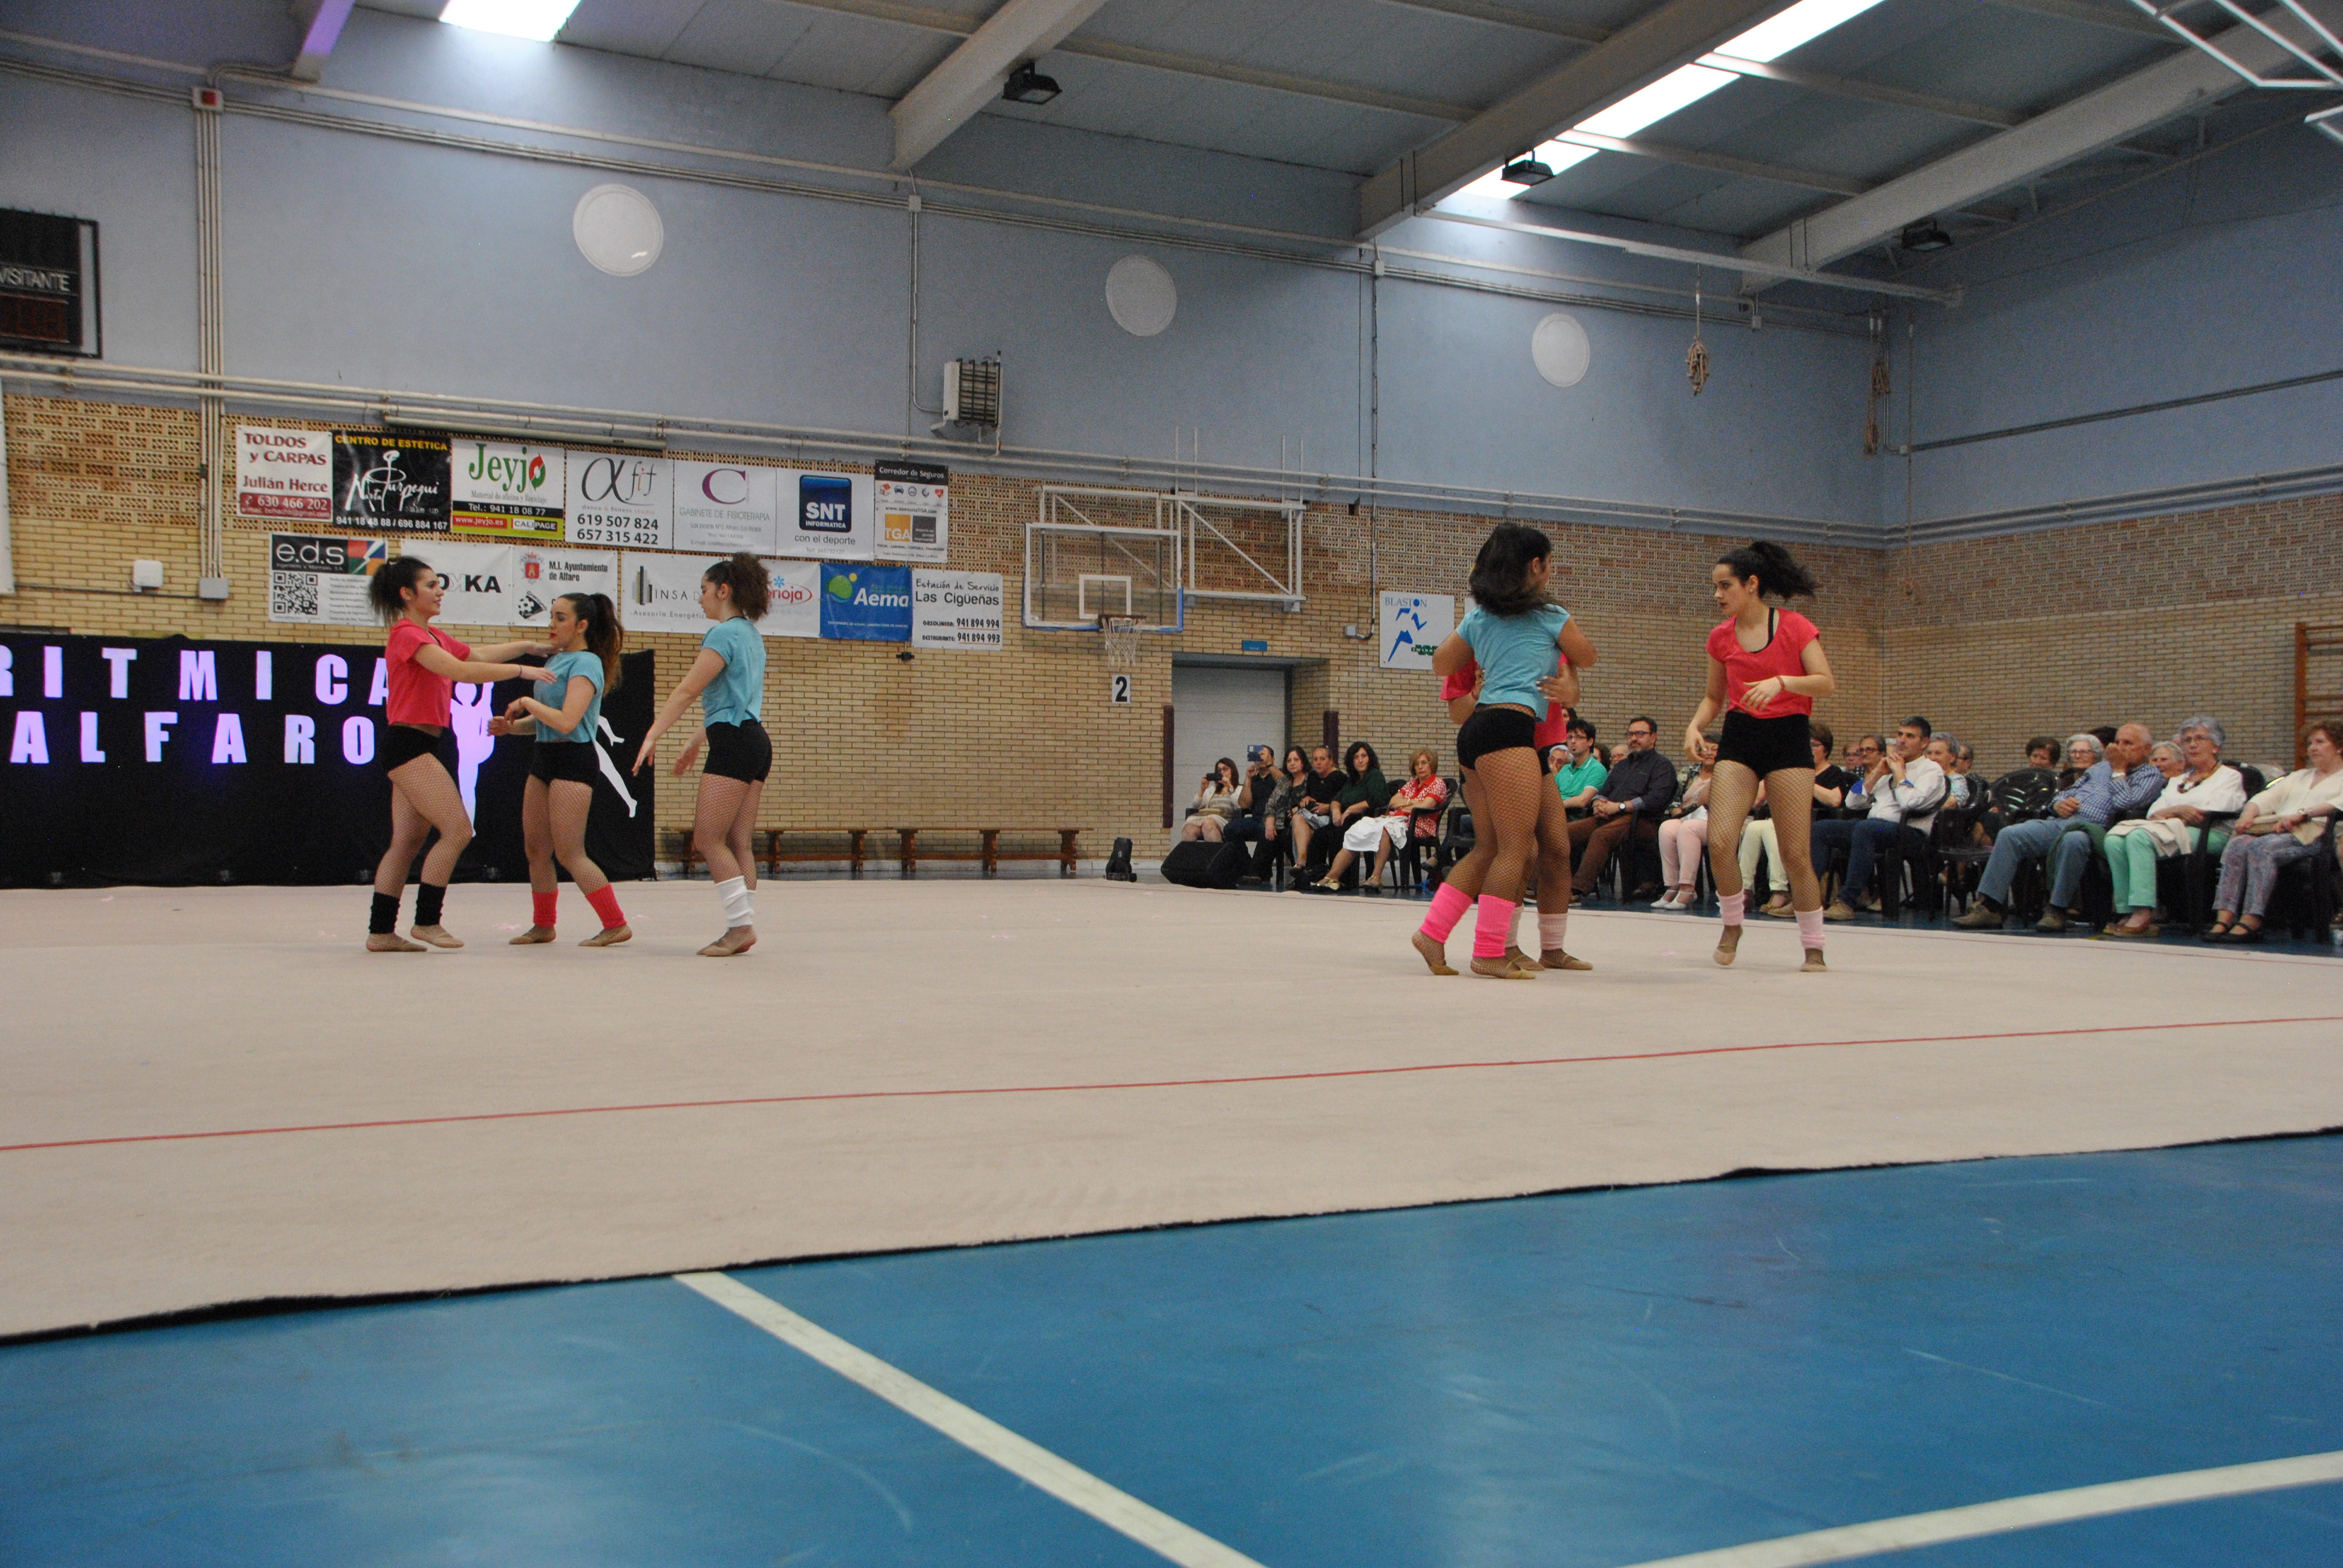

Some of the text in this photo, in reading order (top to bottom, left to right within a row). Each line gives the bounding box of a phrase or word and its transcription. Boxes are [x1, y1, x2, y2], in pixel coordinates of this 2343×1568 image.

[245, 433, 307, 448] TOLDOS
[335, 435, 379, 445] CENTRO
[381, 438, 395, 446] DE
[250, 451, 327, 465] y CARPAS
[468, 443, 546, 493] Jeyjo
[920, 471, 944, 479] Seguros
[243, 475, 328, 492] Julián Herce
[702, 468, 746, 505] C
[258, 495, 327, 510] 630 466 202
[680, 508, 770, 521] GABINETE DE FISIOTERAPIA
[806, 502, 845, 521] SNT
[336, 516, 352, 525] 941
[355, 517, 365, 525] 18
[367, 517, 378, 526] 48
[381, 518, 391, 527] 88
[398, 519, 413, 528] 696
[416, 520, 430, 529] 884
[433, 521, 448, 530] 167
[455, 517, 504, 526] www.jeyjo.es
[577, 514, 658, 530] 619 507 824
[805, 520, 846, 529] INFORMATICA
[577, 529, 658, 545] 657 315 422
[824, 535, 856, 546] deporte
[885, 528, 911, 540] TGA
[549, 561, 608, 572] M.I. Ayuntamiento
[559, 573, 580, 581] Alfaro
[916, 578, 950, 589] Estación
[954, 581, 964, 590] de
[967, 581, 999, 592] Servicio
[655, 589, 688, 600] INSA
[854, 588, 909, 607] Aema
[916, 590, 1000, 607] Las Cigüeñas
[670, 611, 706, 619] Energétic
[957, 618, 969, 627] 941
[971, 618, 984, 628] 894
[986, 619, 1000, 629] 994
[957, 632, 970, 641] 941
[972, 633, 985, 642] 894
[988, 633, 1000, 643] 993
[1115, 676, 1128, 702] 2
[10, 711, 375, 765] ALFARO
